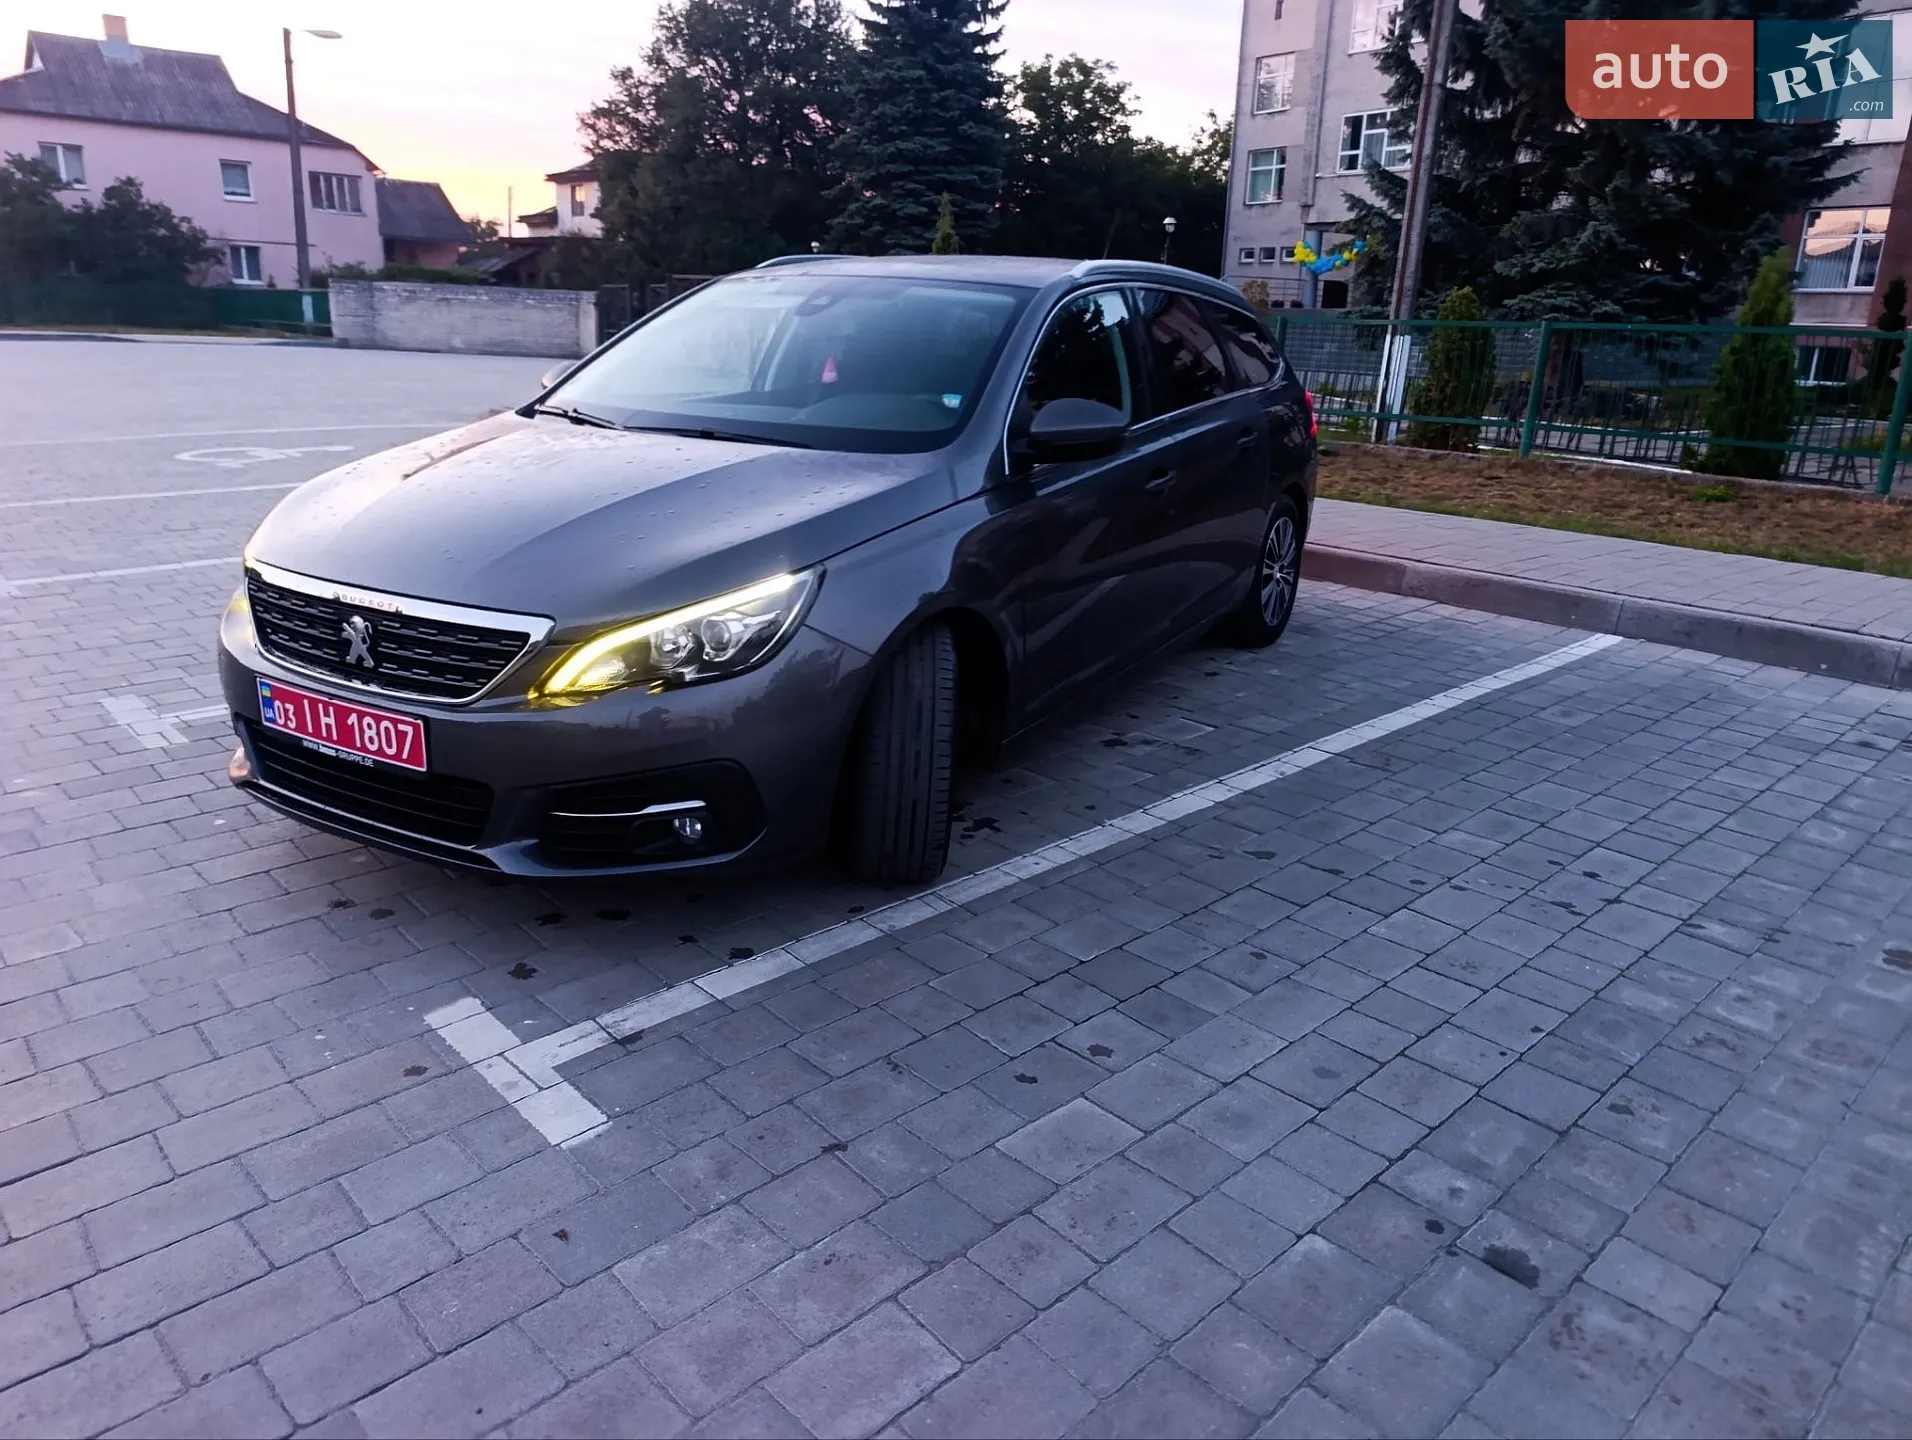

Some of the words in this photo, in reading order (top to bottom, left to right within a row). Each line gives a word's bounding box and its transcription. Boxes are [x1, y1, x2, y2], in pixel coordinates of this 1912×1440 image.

[264, 708, 275, 720] UA
[274, 700, 297, 730] 03
[347, 713, 414, 760] 1807
